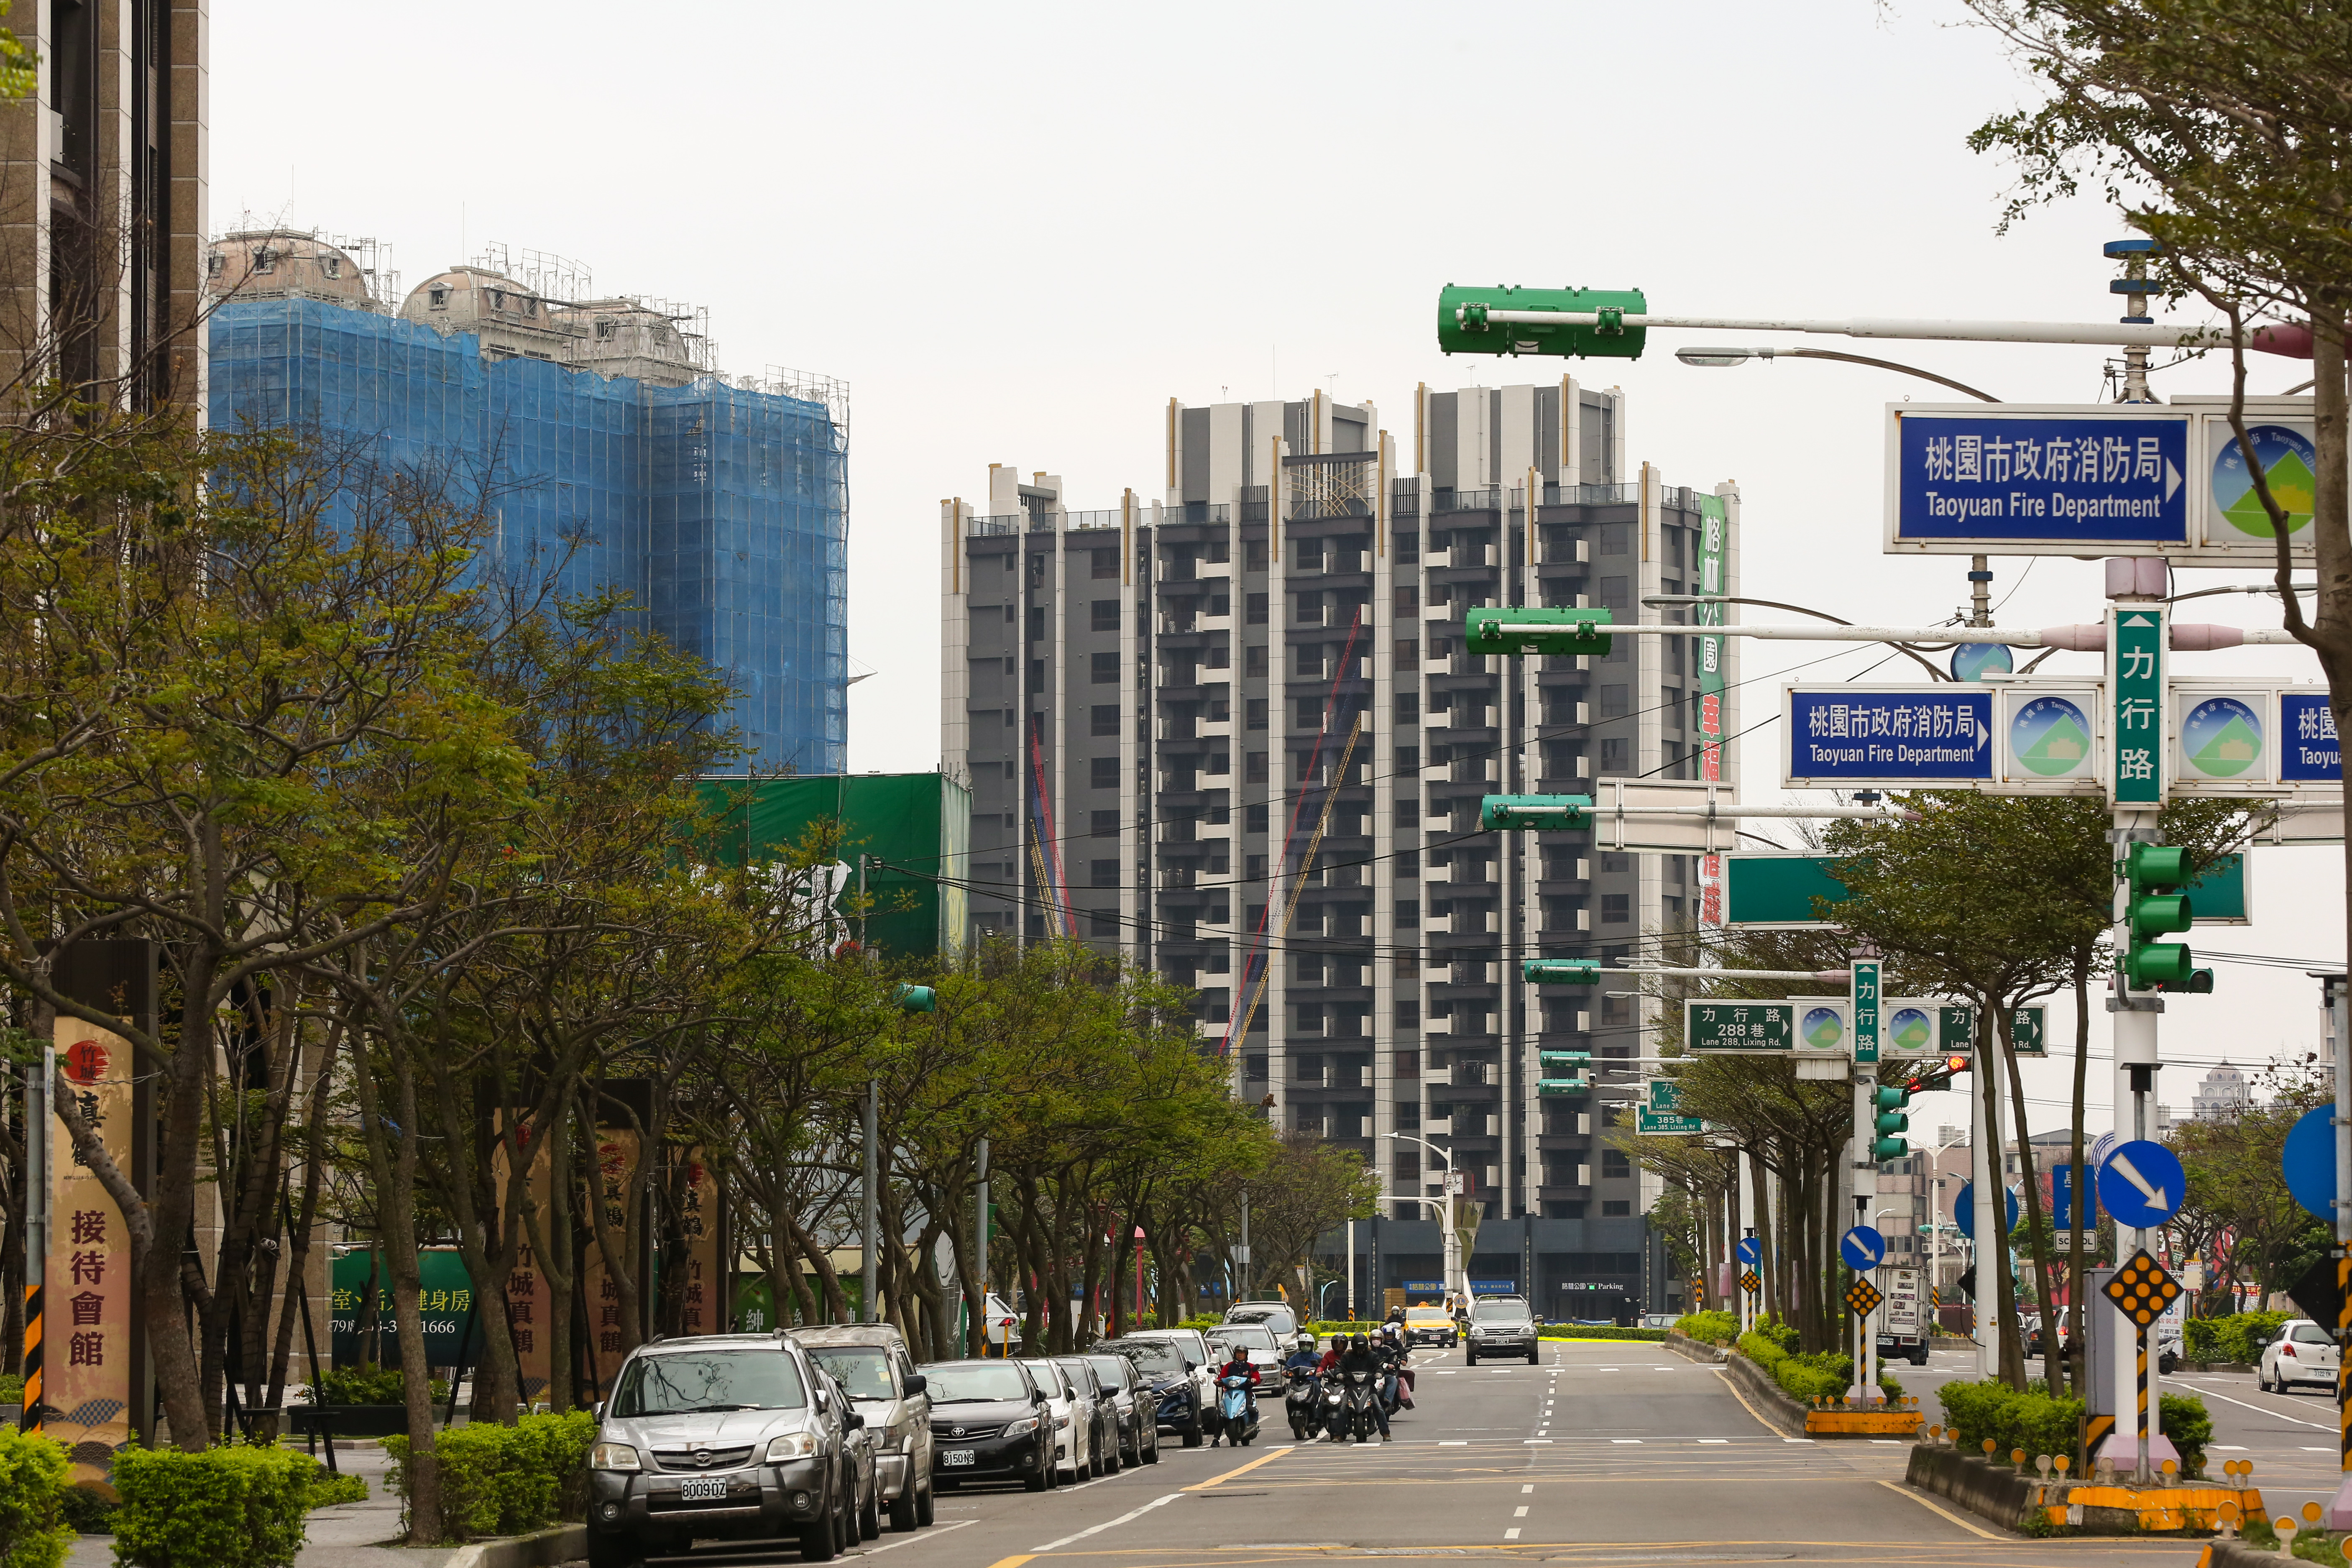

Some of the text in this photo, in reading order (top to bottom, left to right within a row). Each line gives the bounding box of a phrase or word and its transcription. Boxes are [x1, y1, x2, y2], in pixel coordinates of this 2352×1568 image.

[2271, 432, 2303, 452] Taoyuan
[1925, 435, 2161, 484] 桃園市政府消防局
[1926, 491, 2160, 523] Taoyuan Fire Department
[1809, 704, 1974, 738] 桃園市政府消防局
[2019, 702, 2044, 728] 桃園市
[2051, 701, 2073, 715] Taoyuan
[2120, 645, 2155, 780] 力行路
[2191, 703, 2216, 729] 桃園市
[2223, 702, 2246, 716] Taoyuan
[1810, 744, 1974, 766] Taoyuan Fire Department
[1702, 1008, 1781, 1023] 力行路
[1857, 982, 1876, 1051] 力行路
[1722, 1038, 1740, 1047] 288,
[1743, 1038, 1766, 1047] Lixing
[1951, 1040, 1969, 1048] Lane
[79, 1046, 97, 1081] 竹城
[69, 1210, 106, 1367] 接待會館
